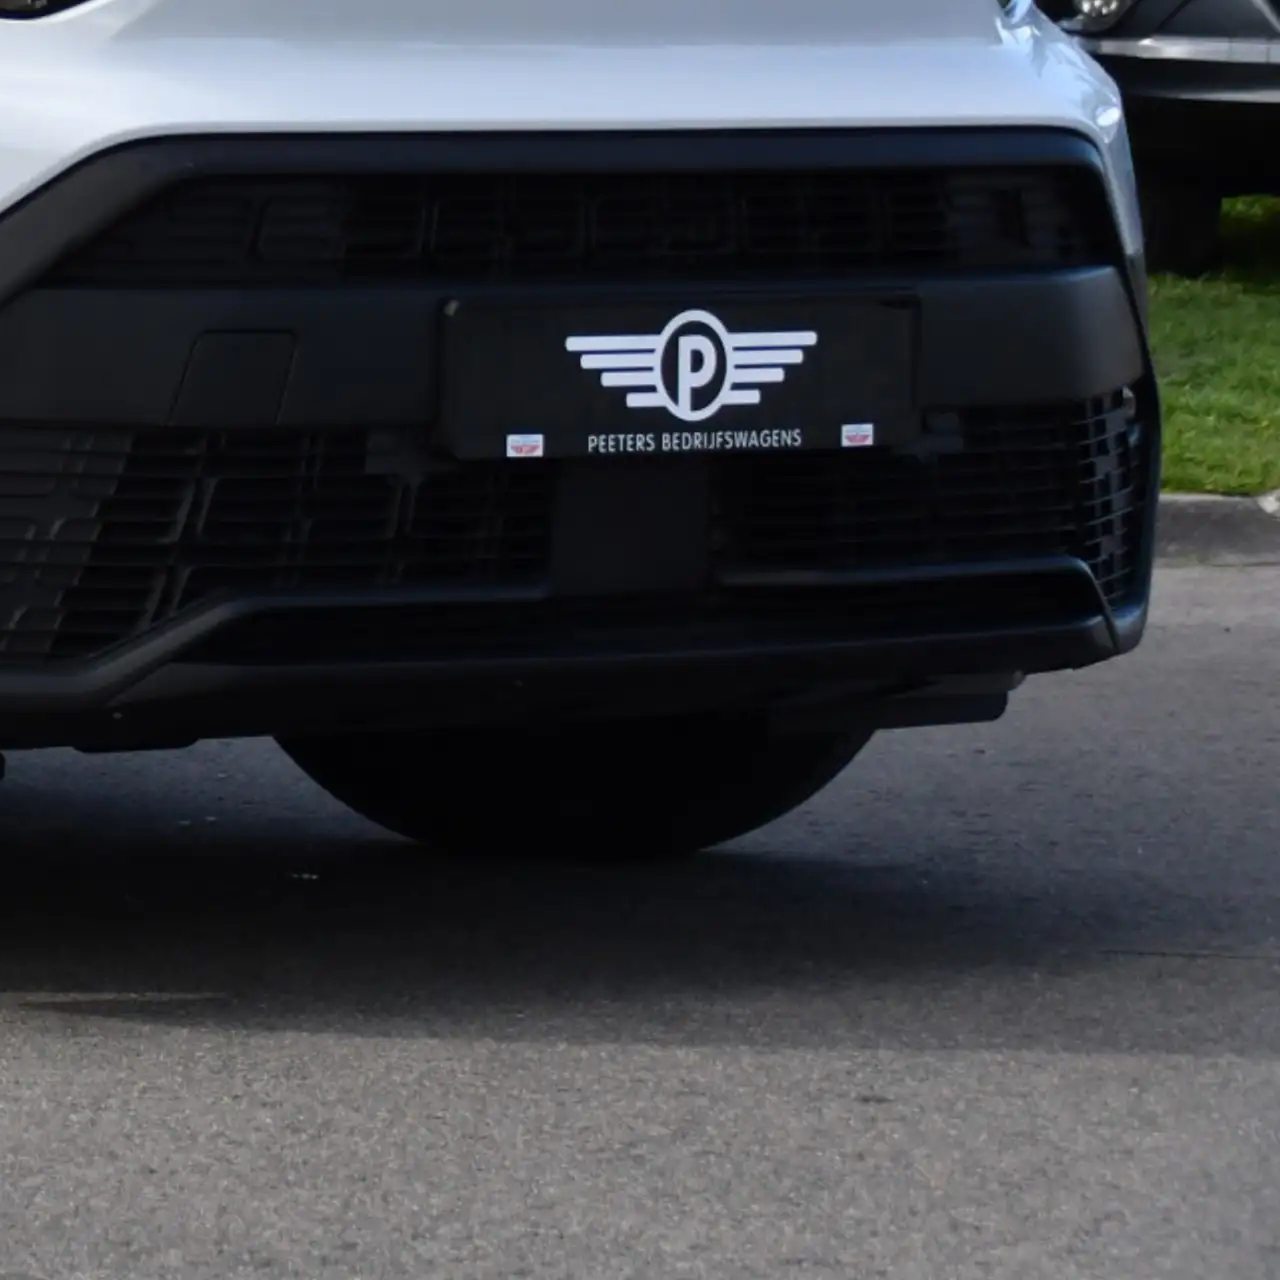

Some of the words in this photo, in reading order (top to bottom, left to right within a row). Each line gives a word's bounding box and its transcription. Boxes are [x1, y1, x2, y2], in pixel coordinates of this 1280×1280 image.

[677, 334, 718, 412] P
[587, 433, 656, 453] PEETERS
[661, 428, 803, 452] BEDRIJFSWAGENS
